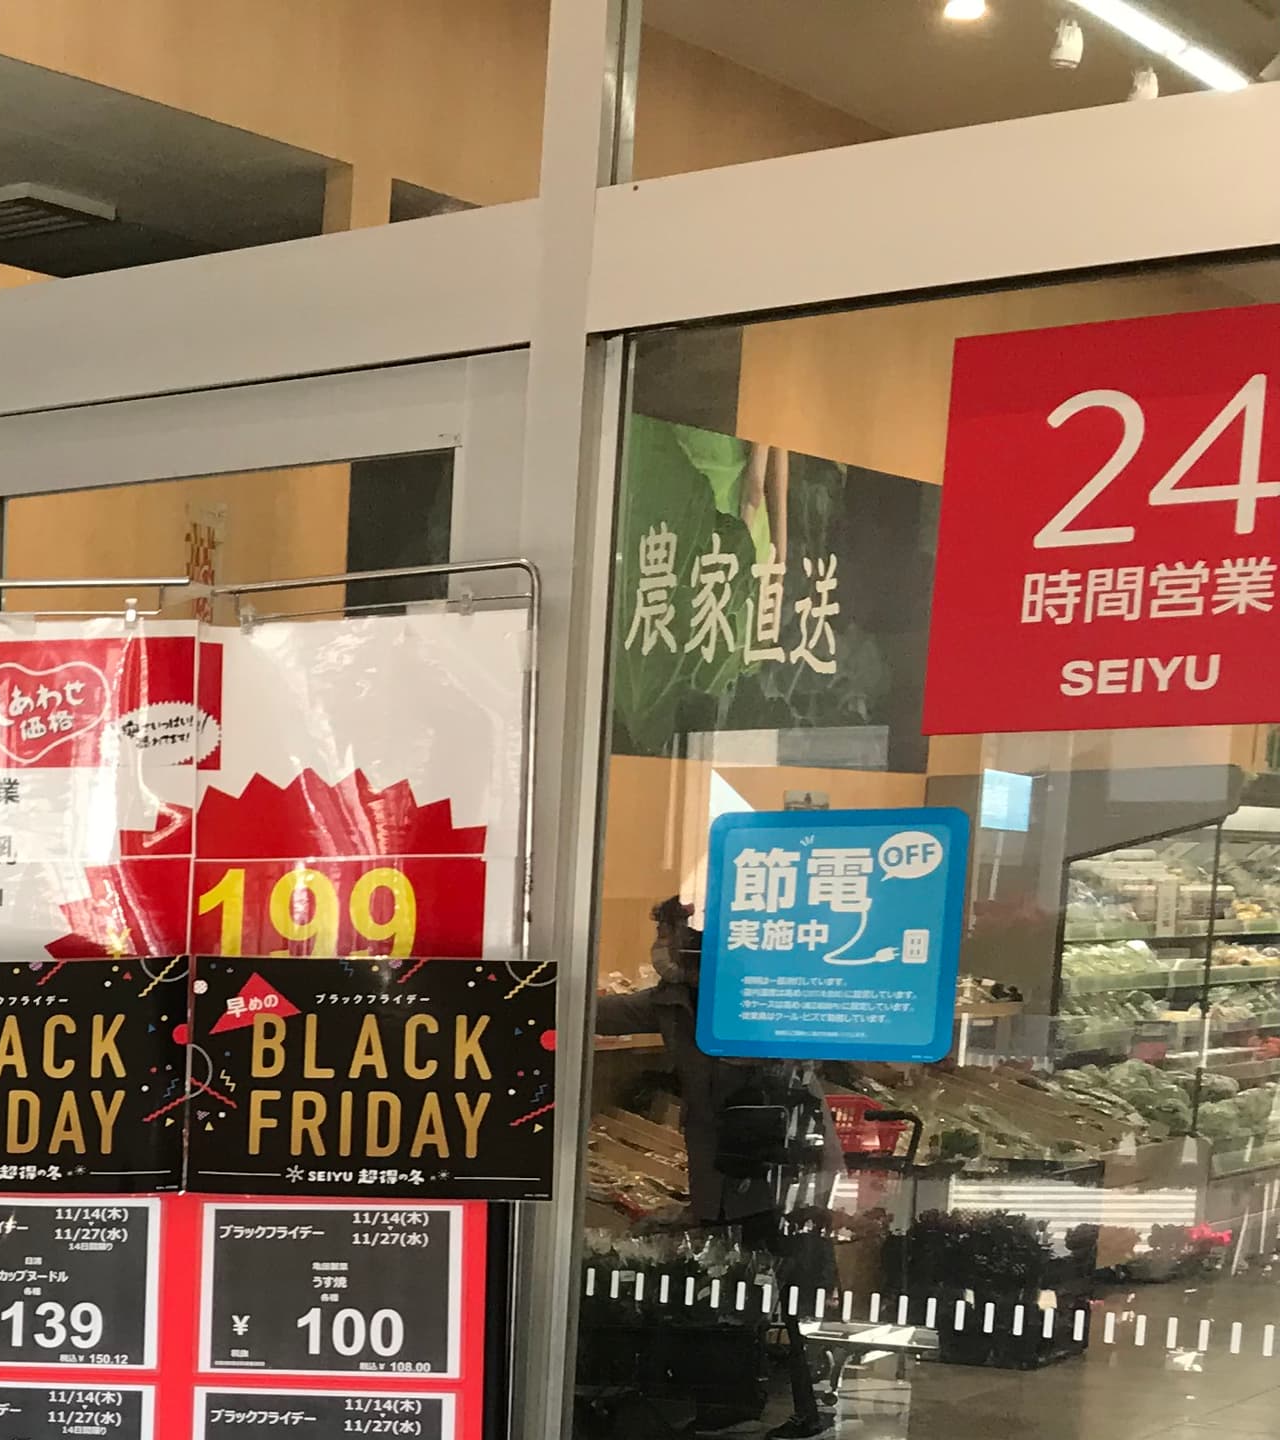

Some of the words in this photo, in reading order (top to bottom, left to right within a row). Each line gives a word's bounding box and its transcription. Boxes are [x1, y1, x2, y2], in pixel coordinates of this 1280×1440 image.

[1033, 373, 1280, 549] 24
[625, 521, 840, 675] 農家直送
[1020, 556, 1278, 626] 時間営業
[1060, 654, 1221, 697] SEIYU
[883, 843, 936, 868] OFF
[730, 848, 874, 913] 節電
[198, 867, 417, 959] 199
[727, 919, 829, 951] 実施中
[226, 994, 279, 1018] 早めの
[315, 993, 430, 1005] ブラックフライデー
[251, 1014, 492, 1080] BLACK
[248, 1090, 491, 1159] FRIDAY
[307, 1170, 353, 1183] SEIYU
[55, 1208, 128, 1222] 11/14(木)
[352, 1212, 429, 1226] 11/14(木)
[54, 1227, 128, 1242] 11/27(水)
[219, 1225, 324, 1240] ブラックフライデー
[352, 1233, 428, 1247] 11/27(水)
[0, 1301, 103, 1348] 139
[232, 1315, 250, 1335] ¥
[297, 1307, 404, 1356] 100
[89, 1354, 128, 1364] 150.12
[390, 1362, 431, 1372] 108.00
[49, 1391, 122, 1406] 11/14(木)
[345, 1399, 421, 1414] 11/14(木)
[48, 1411, 121, 1426] 11/27(水)
[210, 1410, 316, 1425] ブラックフライデー
[344, 1420, 421, 1435] 11/27(水)
